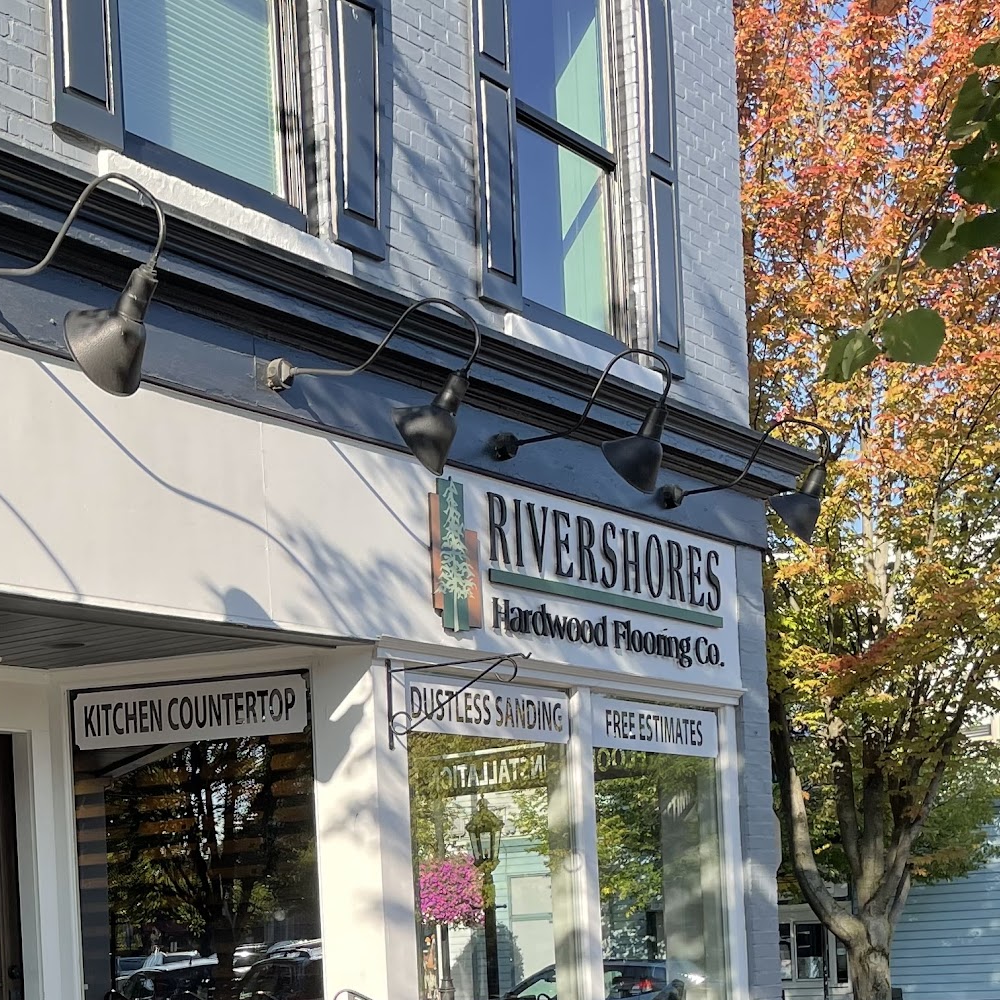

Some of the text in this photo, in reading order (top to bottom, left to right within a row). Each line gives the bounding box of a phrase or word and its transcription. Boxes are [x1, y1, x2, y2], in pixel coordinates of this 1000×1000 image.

[486, 491, 722, 612] RIVERSHORES
[492, 597, 725, 668] Hardwood Flooring Co.
[84, 688, 296, 737] KITCHEN COUNTERTOP
[410, 686, 563, 732] DUSTLESS SANDING
[605, 709, 703, 747] FREE ESTIMATES
